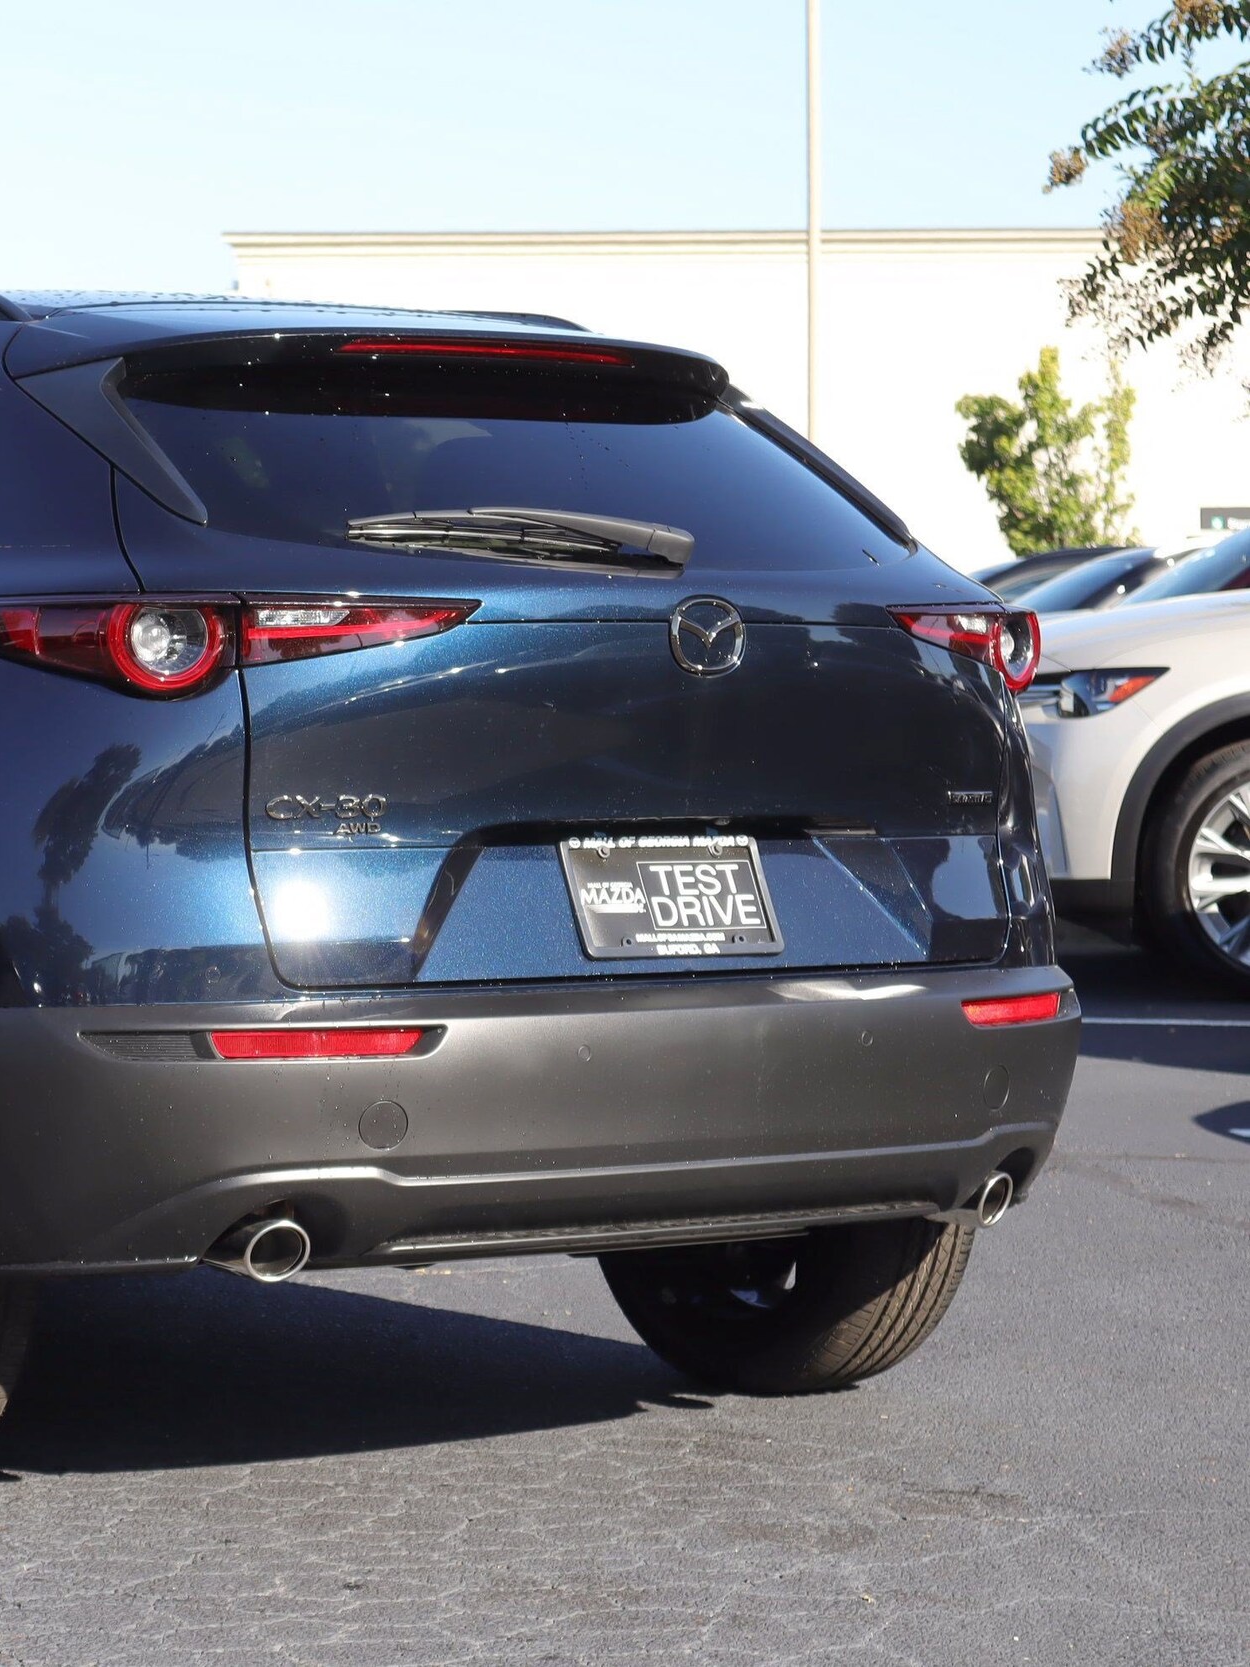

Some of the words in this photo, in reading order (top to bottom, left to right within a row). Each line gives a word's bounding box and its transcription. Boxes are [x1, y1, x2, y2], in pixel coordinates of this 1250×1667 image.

[265, 794, 388, 820] CX-30
[335, 822, 382, 835] AWD
[618, 837, 636, 848] OF
[649, 864, 739, 896] TEST
[580, 887, 646, 905] MAZDA
[650, 894, 761, 927] DRIVE
